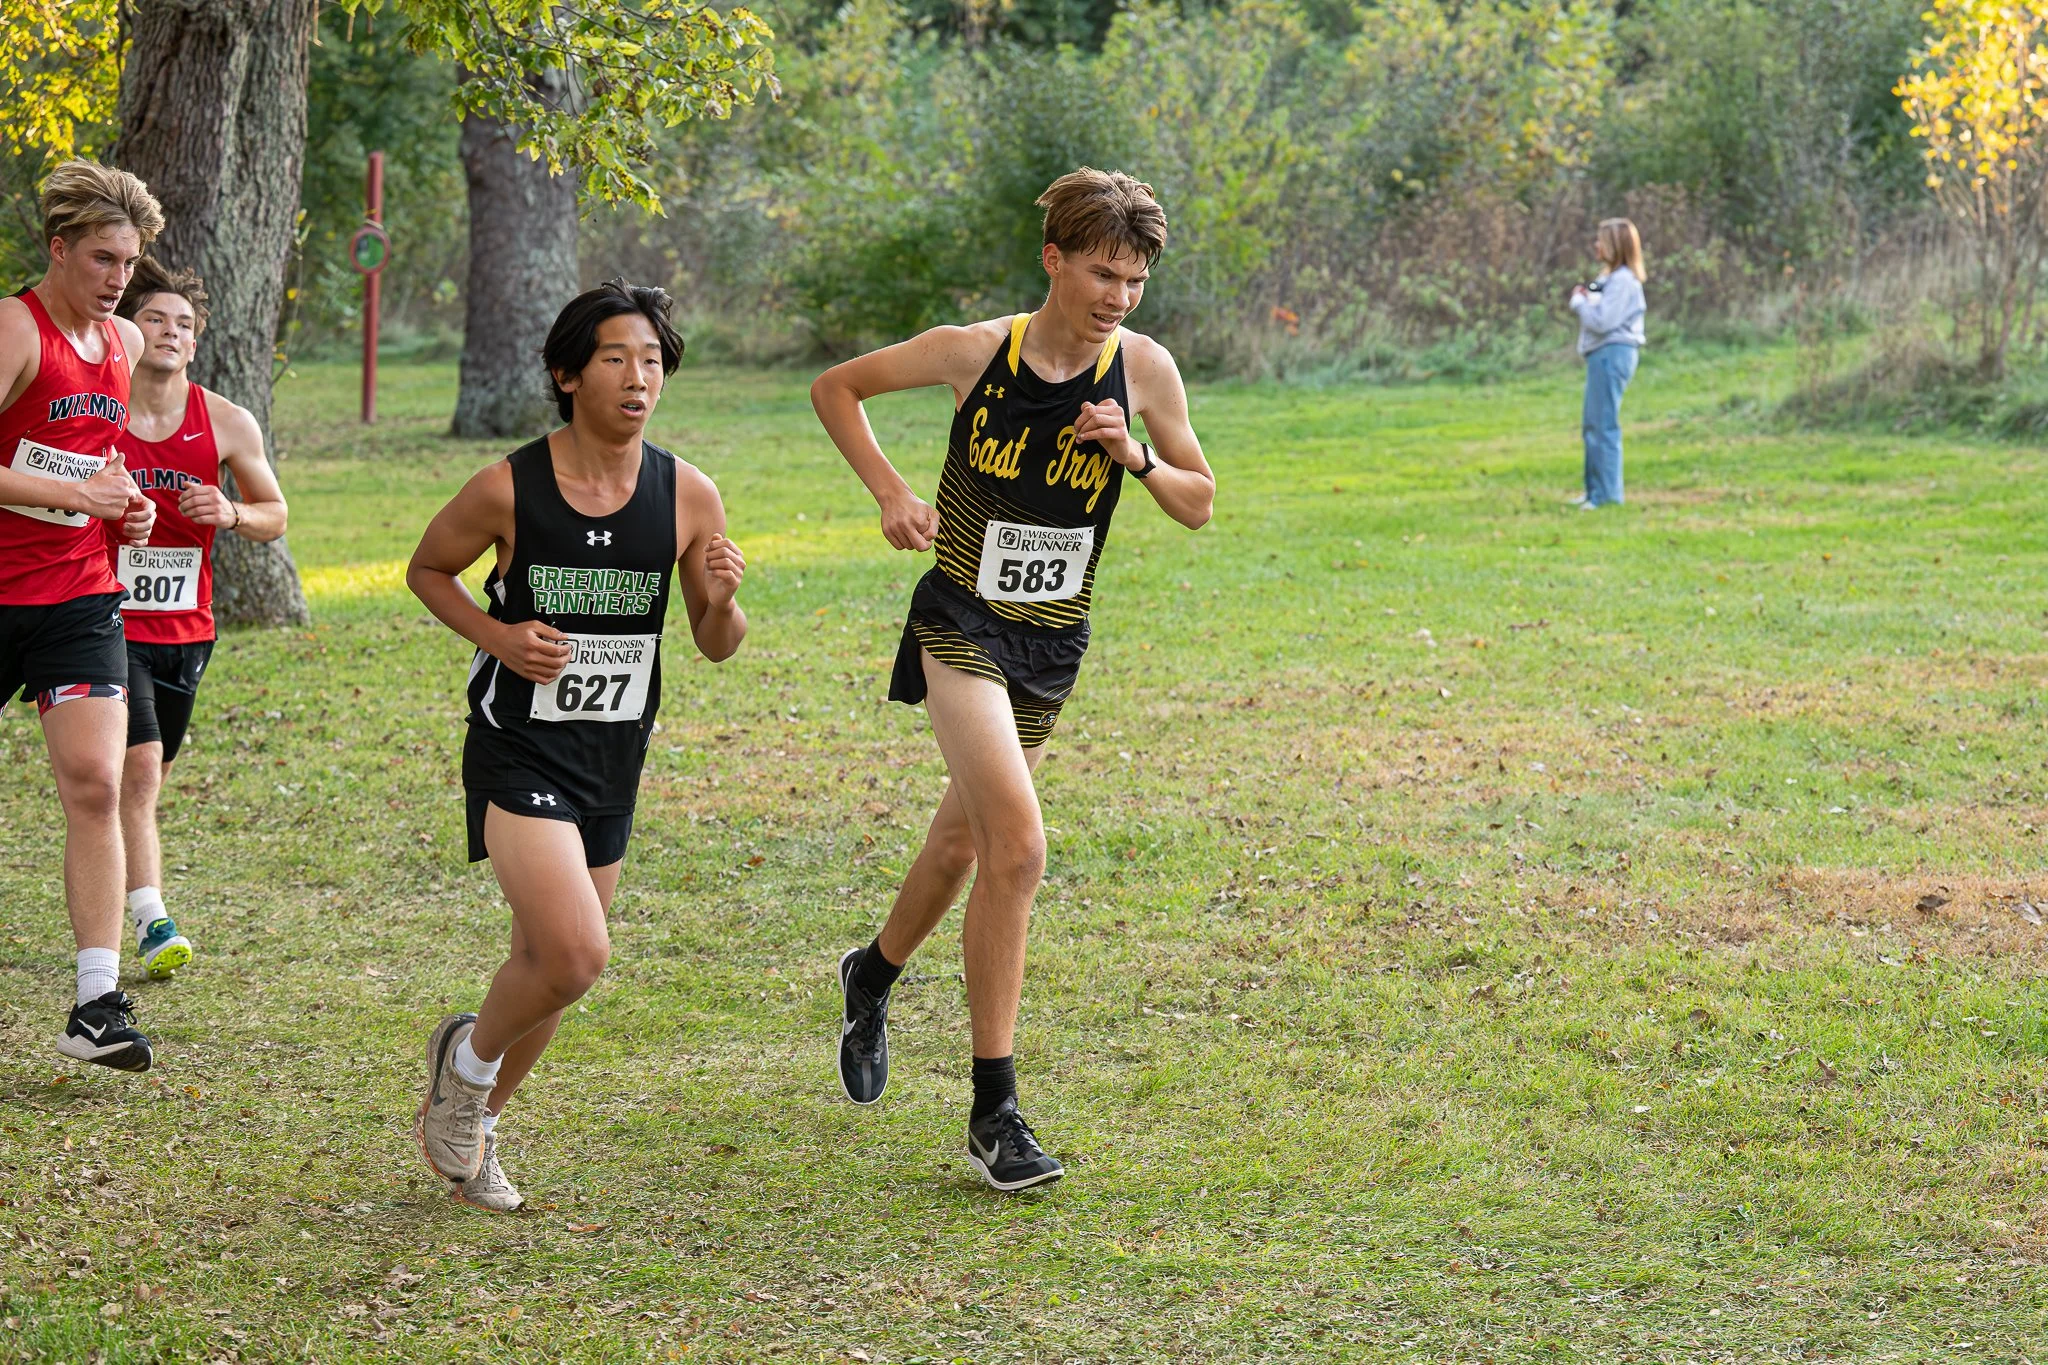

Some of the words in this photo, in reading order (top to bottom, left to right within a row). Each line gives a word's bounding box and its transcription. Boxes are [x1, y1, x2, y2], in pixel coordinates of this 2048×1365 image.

[48, 392, 126, 431] WILMOT
[56, 453, 100, 468] WISCONSIN
[969, 407, 1030, 480] East
[1045, 425, 1113, 513] Troy
[1021, 539, 1082, 551] RUNNER
[1028, 530, 1084, 540] WISCONSIN
[147, 557, 194, 569] RUNNER
[152, 550, 194, 558] WISCONSIN
[528, 565, 661, 596] GREENDALE
[997, 558, 1068, 593] 583
[133, 575, 186, 603] 807
[533, 589, 653, 615] PANTHERS
[587, 639, 645, 649] WISCONSIN
[579, 650, 643, 665] RUNNER
[556, 673, 631, 712] 627
